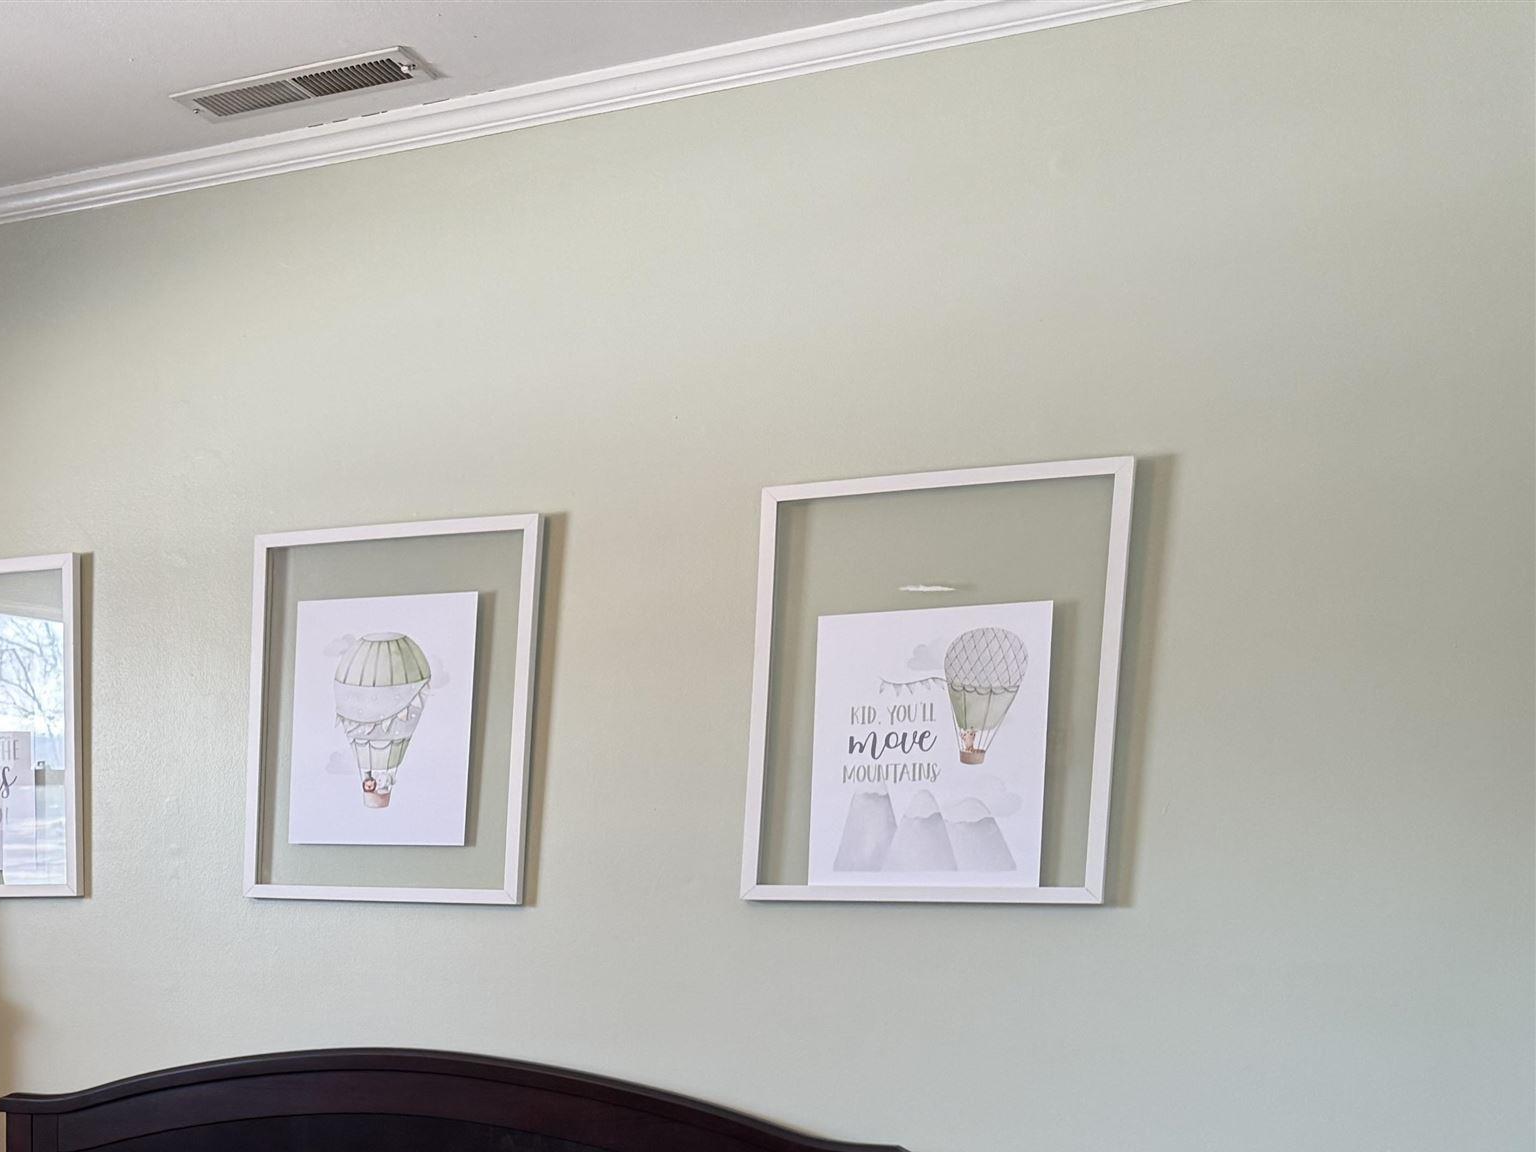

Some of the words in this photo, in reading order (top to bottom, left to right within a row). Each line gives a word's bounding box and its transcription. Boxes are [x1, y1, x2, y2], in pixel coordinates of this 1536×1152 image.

[886, 702, 937, 726] YOU'LL
[848, 729, 938, 761] move
[842, 762, 942, 784] MOUNTAINS
